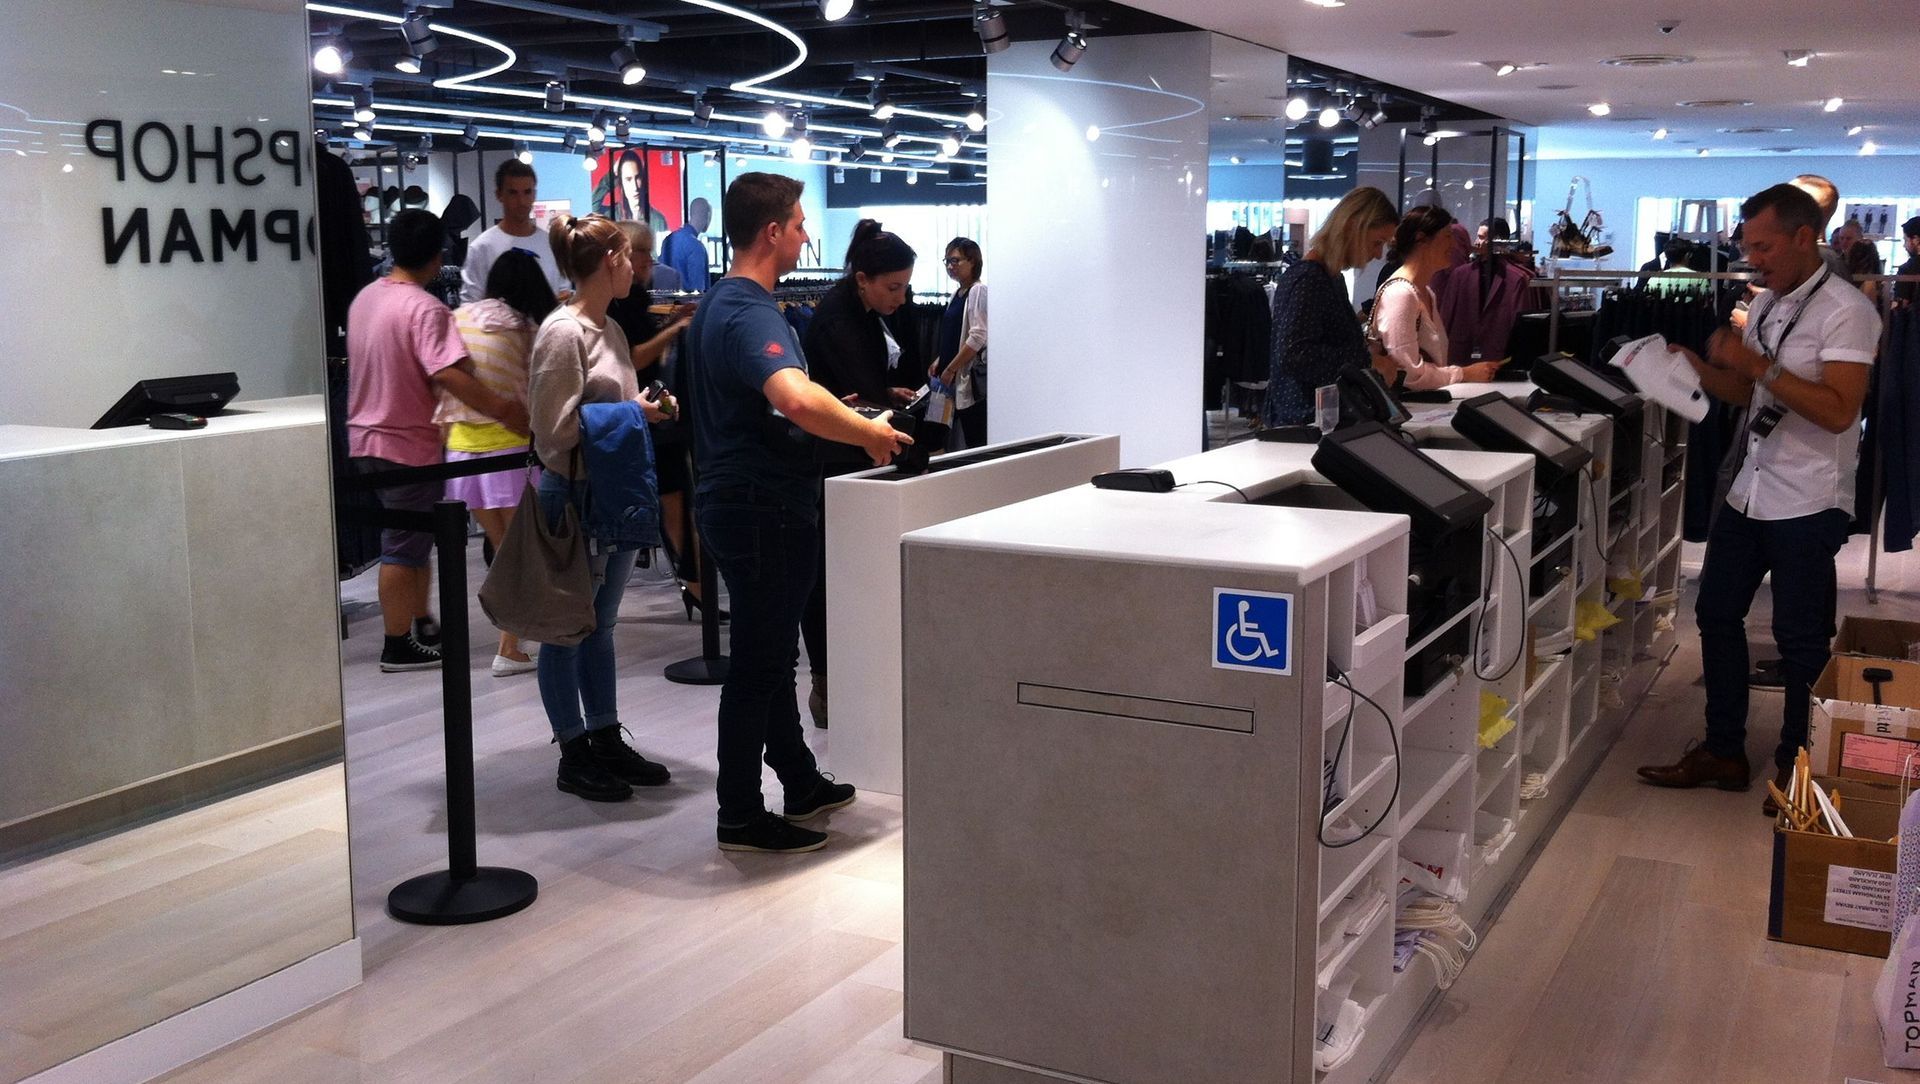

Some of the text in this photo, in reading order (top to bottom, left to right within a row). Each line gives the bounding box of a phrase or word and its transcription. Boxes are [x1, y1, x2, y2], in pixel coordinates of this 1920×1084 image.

[1853, 869, 1878, 878] ZEALAND
[1848, 876, 1877, 885] AUCKLAND
[1861, 885, 1891, 894] AUCKLAND
[1904, 961, 1920, 1053] TOPMAN
